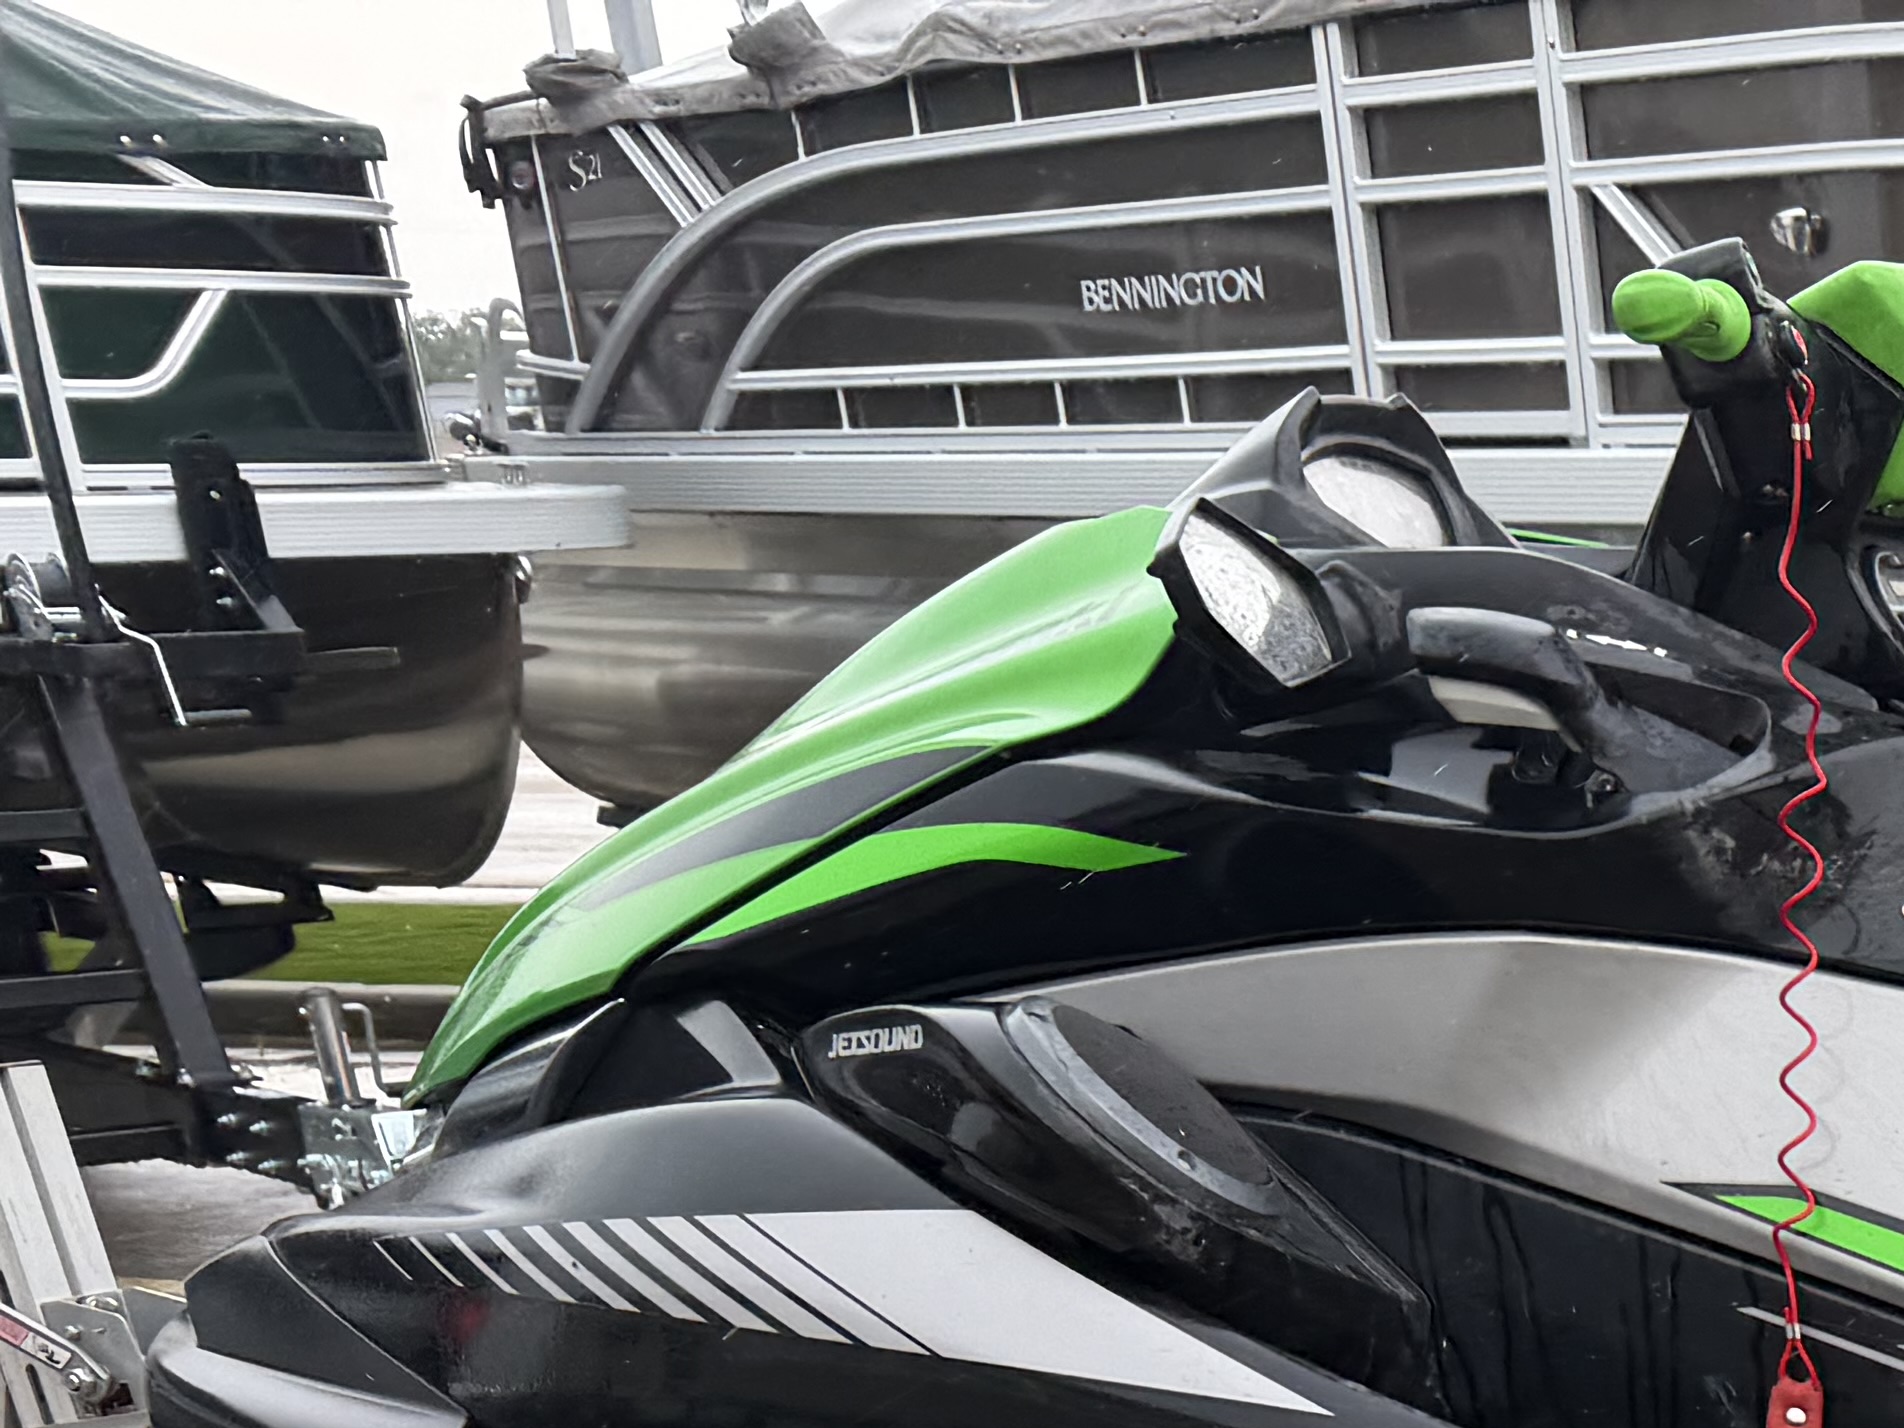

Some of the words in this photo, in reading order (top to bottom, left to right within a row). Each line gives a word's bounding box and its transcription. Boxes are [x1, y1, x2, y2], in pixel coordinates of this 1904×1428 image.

[568, 150, 603, 192] S21
[1080, 265, 1266, 312] BENNINGTON
[827, 1024, 924, 1058] JETSOUND
